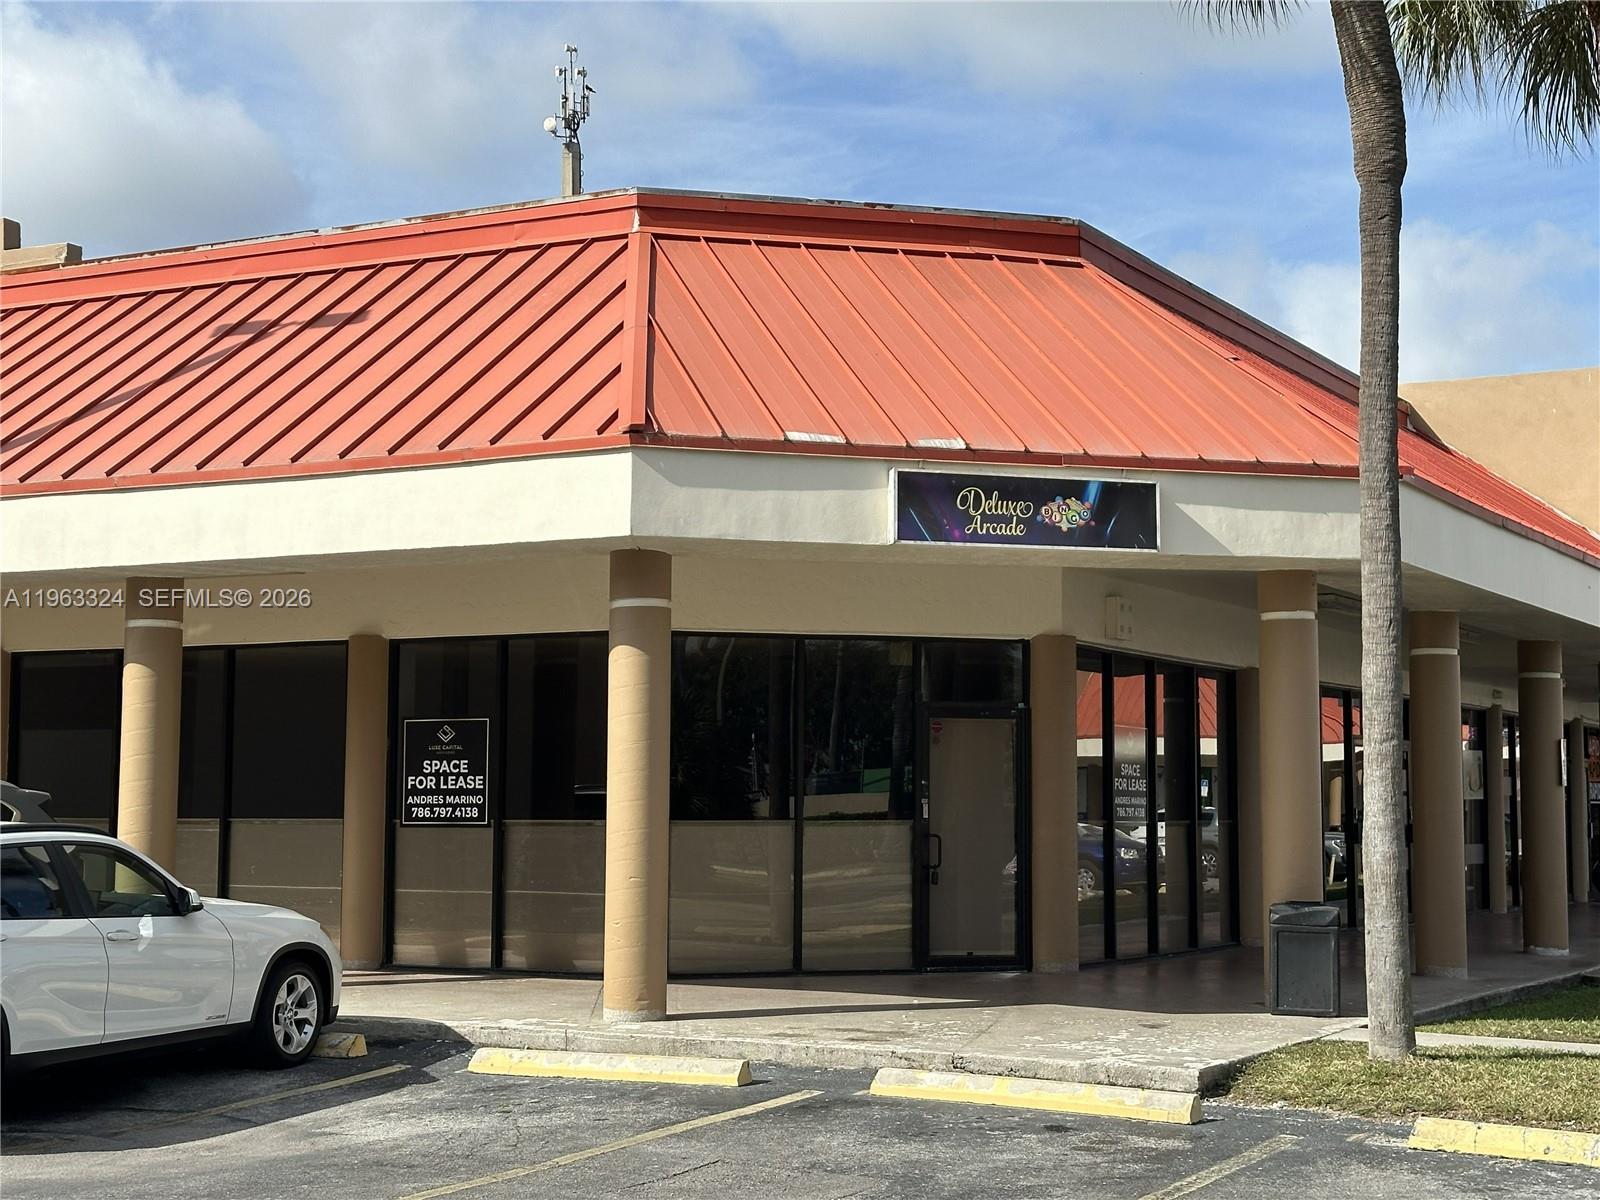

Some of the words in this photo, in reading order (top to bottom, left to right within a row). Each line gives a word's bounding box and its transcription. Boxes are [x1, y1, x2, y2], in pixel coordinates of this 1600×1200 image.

[956, 487, 1034, 518] Deluxe
[1041, 502, 1090, 525] BINGO
[964, 515, 1027, 536] Arcade
[422, 759, 469, 773] SPACE
[1120, 763, 1141, 777] SPACE
[407, 776, 436, 789] FOR
[440, 775, 484, 789] LEASE
[1114, 778, 1128, 791] FOR
[1128, 778, 1147, 791] LEASE
[406, 795, 444, 804] ANDRES
[445, 795, 484, 804] MARINO
[411, 807, 479, 818] 786.797.4138
